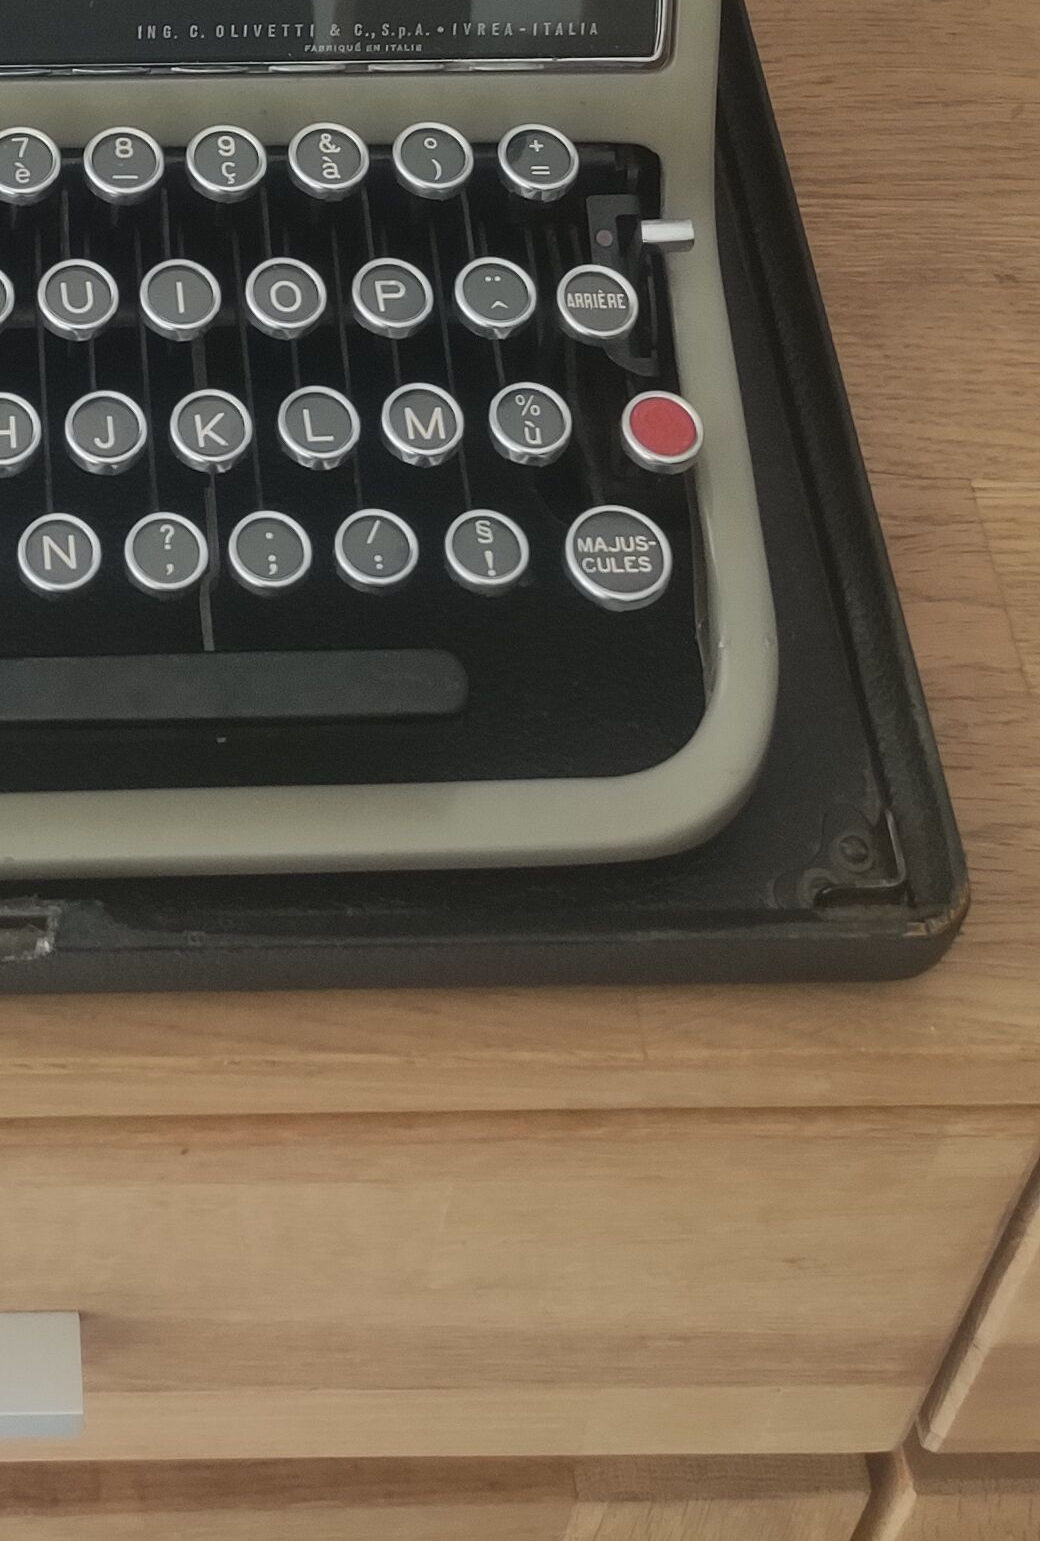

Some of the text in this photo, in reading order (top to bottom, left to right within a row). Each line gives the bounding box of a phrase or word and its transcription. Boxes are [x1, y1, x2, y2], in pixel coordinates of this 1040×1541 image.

[138, 26, 177, 39] ING.
[190, 25, 204, 38] C.
[216, 24, 314, 37] OLIVETTI
[330, 24, 340, 36] &
[305, 42, 361, 52] FABRIQUÉ
[12, 138, 28, 157] 7
[115, 138, 133, 158] 8
[218, 136, 235, 156] 9
[319, 134, 340, 153] &
[15, 163, 30, 183] è
[219, 162, 235, 185] ç
[322, 157, 340, 178] à
[61, 282, 93, 313] U
[176, 282, 184, 313] I
[271, 281, 301, 312] O
[375, 281, 405, 311] P
[565, 287, 628, 312] ARRIÈRE
[516, 395, 540, 416] %
[94, 416, 114, 448] J
[195, 413, 228, 447] K
[303, 409, 334, 441] L
[405, 407, 445, 439] M
[525, 421, 541, 444] ù
[160, 525, 174, 549] ?
[476, 521, 493, 543] §
[43, 535, 76, 570] N
[578, 536, 657, 552] MAJUS-
[580, 556, 652, 575] CULES
